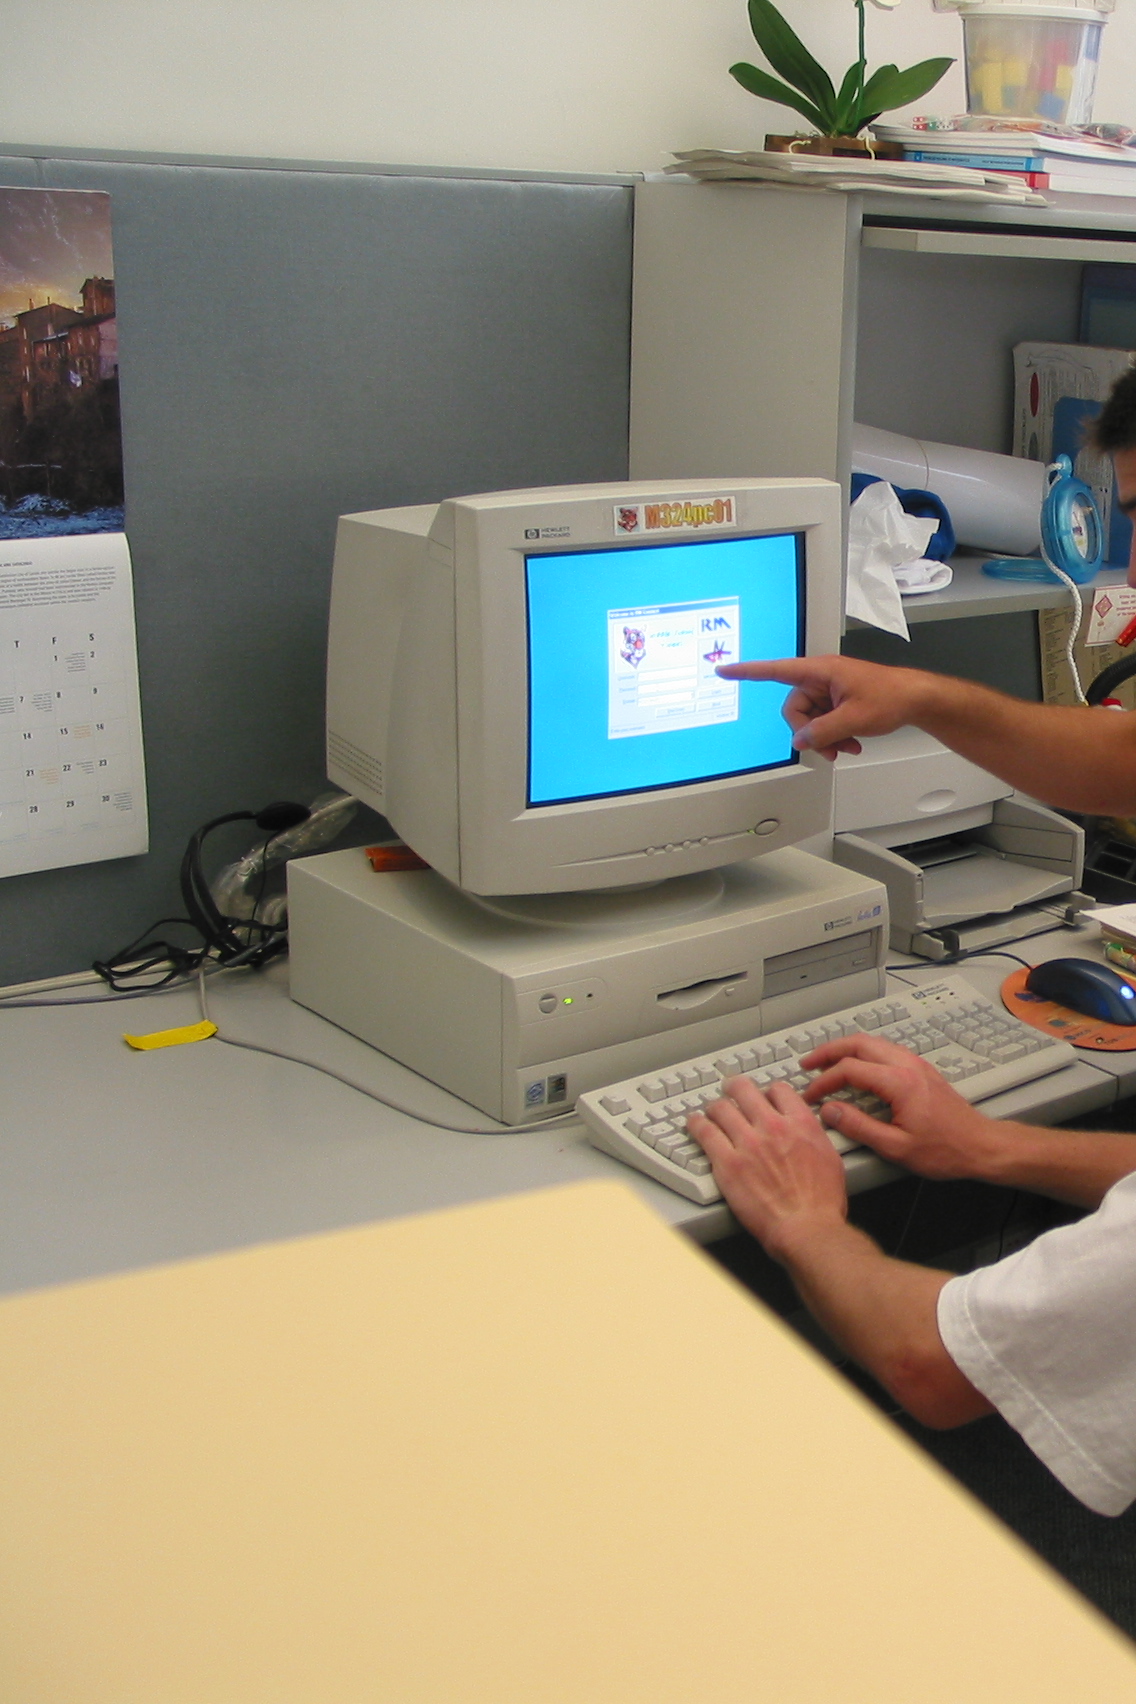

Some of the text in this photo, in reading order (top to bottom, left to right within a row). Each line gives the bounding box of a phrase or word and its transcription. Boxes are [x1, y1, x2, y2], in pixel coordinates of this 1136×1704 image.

[644, 498, 732, 529] M324pc01
[701, 617, 731, 632] RM
[14, 633, 94, 648] T F S
